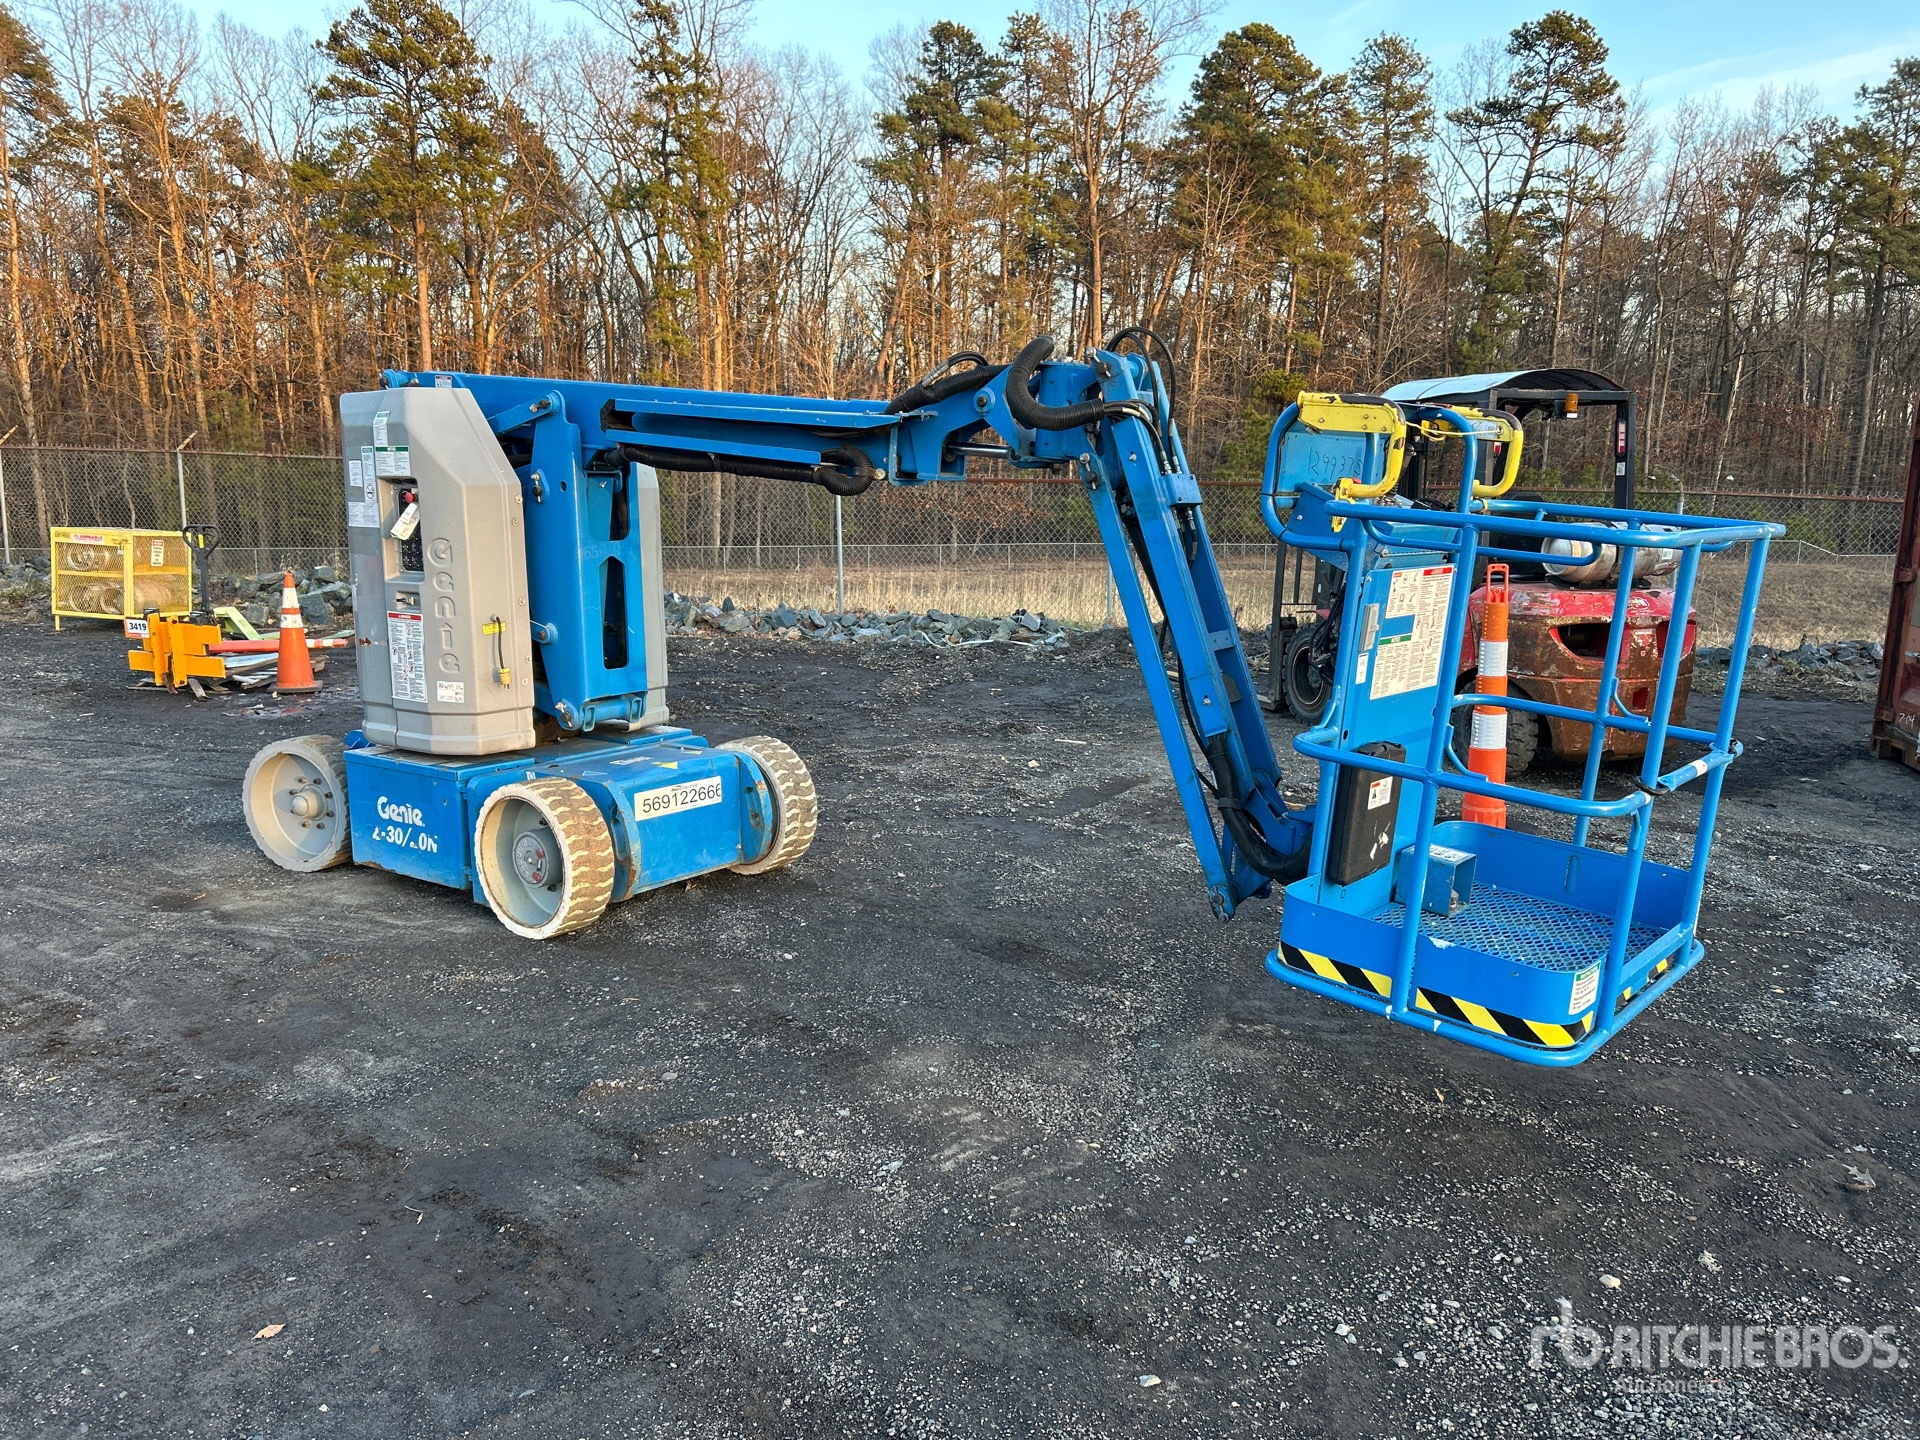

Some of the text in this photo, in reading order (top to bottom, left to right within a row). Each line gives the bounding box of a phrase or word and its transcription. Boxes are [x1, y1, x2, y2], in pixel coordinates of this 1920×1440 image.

[129, 622, 147, 631] 3419
[377, 796, 424, 827] Genie
[642, 782, 721, 813] 569122666
